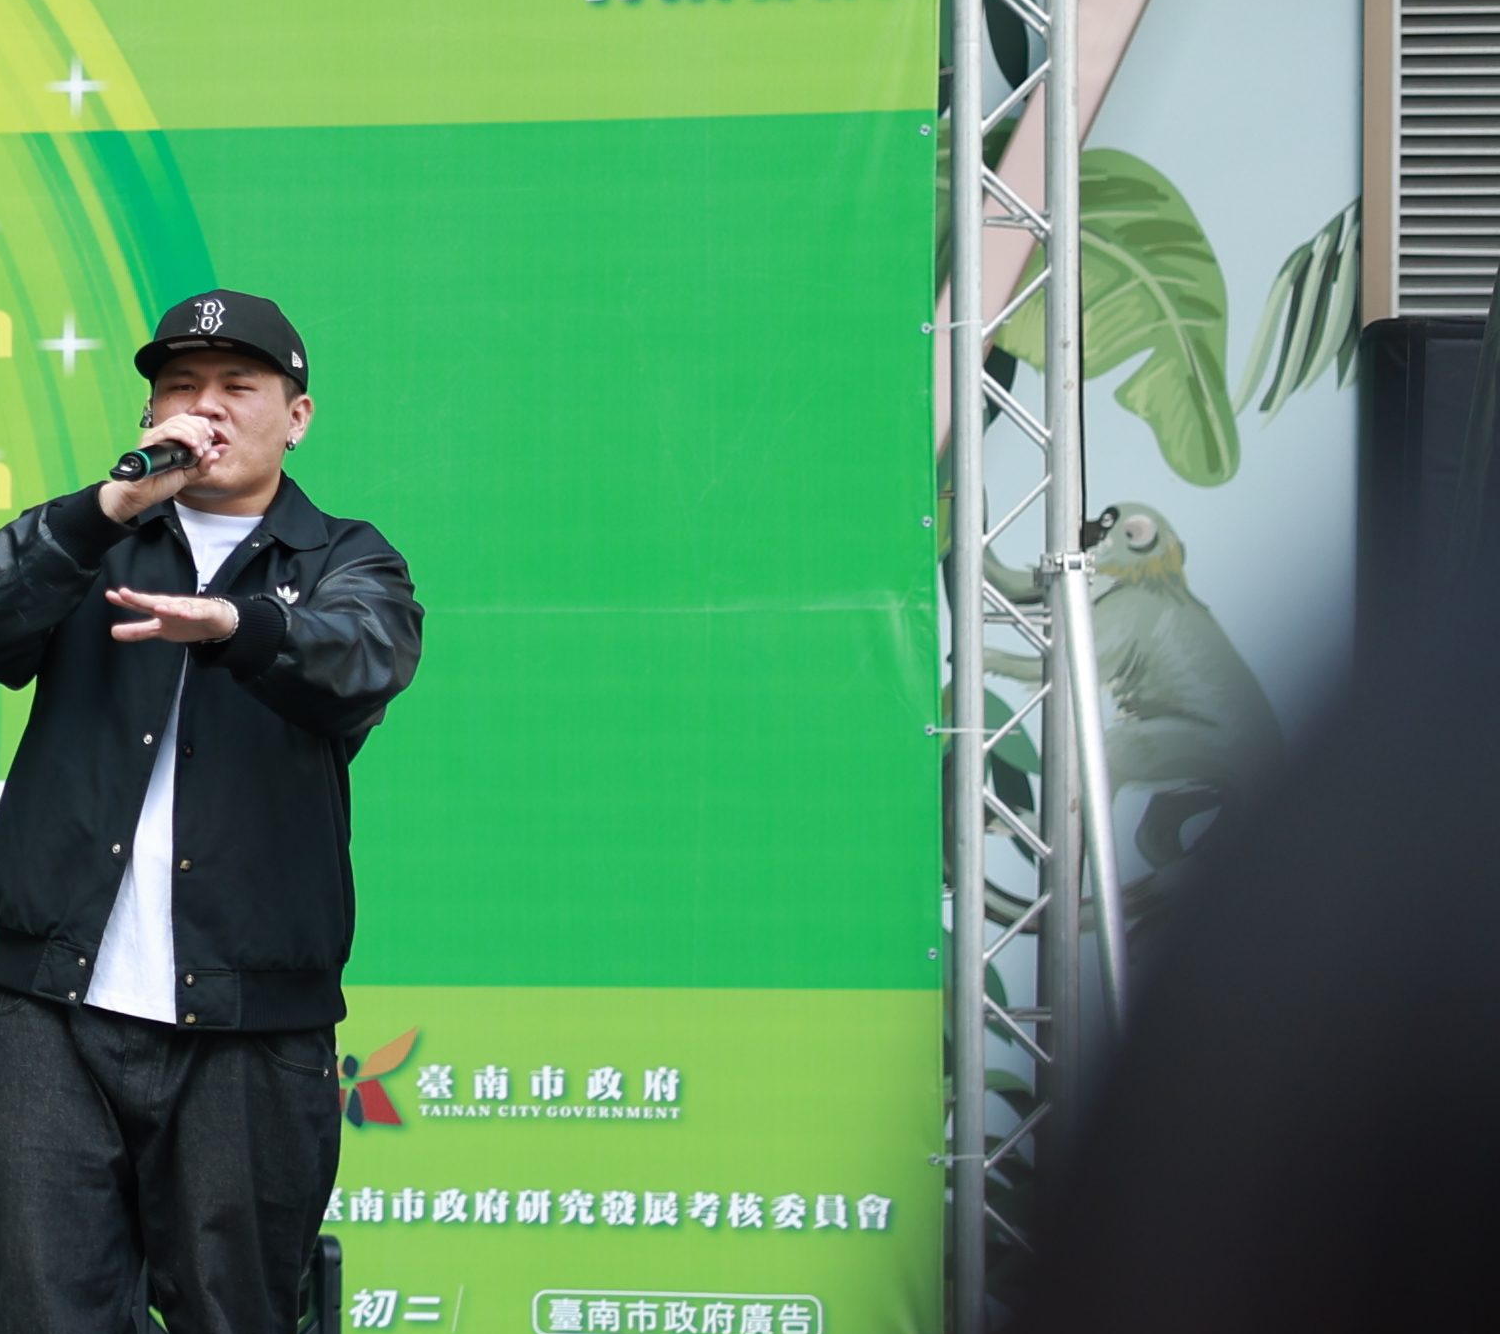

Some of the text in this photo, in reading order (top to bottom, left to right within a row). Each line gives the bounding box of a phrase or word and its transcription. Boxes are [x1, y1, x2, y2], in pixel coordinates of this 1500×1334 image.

[416, 1064, 681, 1102] 臺南市政府
[418, 1104, 681, 1120] TAINAN CITY GOVERNMENT
